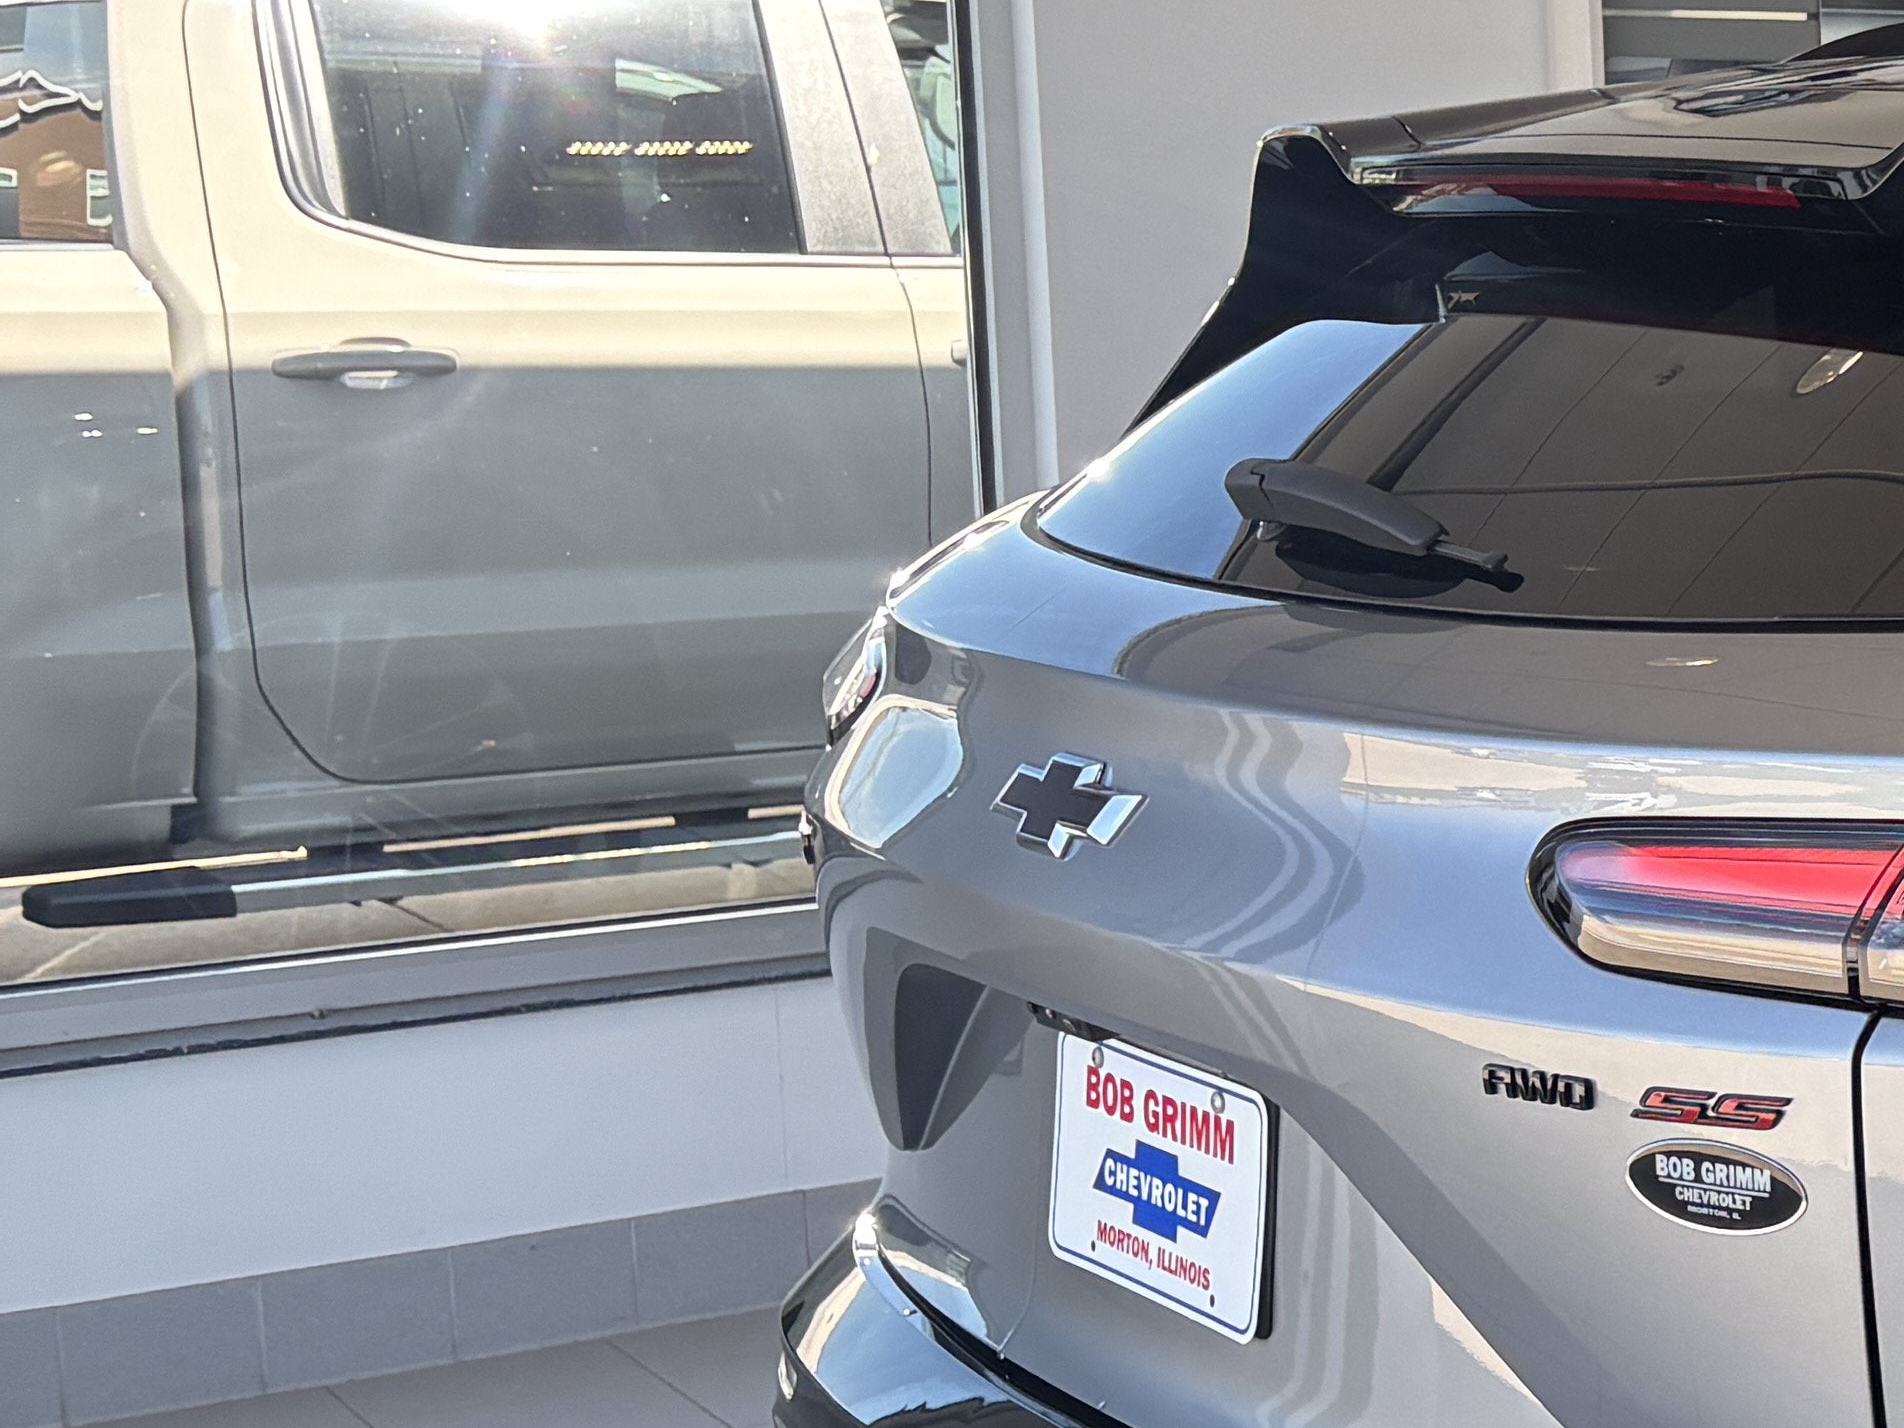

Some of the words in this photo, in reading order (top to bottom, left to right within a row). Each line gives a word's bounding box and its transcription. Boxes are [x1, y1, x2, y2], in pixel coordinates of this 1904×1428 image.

[1086, 1065, 1134, 1123] BOB
[1143, 1089, 1235, 1165] GRIMM
[1482, 1063, 1596, 1110] AWD
[1630, 1086, 1794, 1131] SS
[1104, 1157, 1209, 1227] CHEVROLET
[1655, 1154, 1696, 1181] BOB
[1701, 1161, 1772, 1193] GRIMM
[1675, 1186, 1753, 1211] CHEVROLET
[1096, 1220, 1153, 1270] MORTON,
[1156, 1246, 1210, 1291] ILLINOIS
